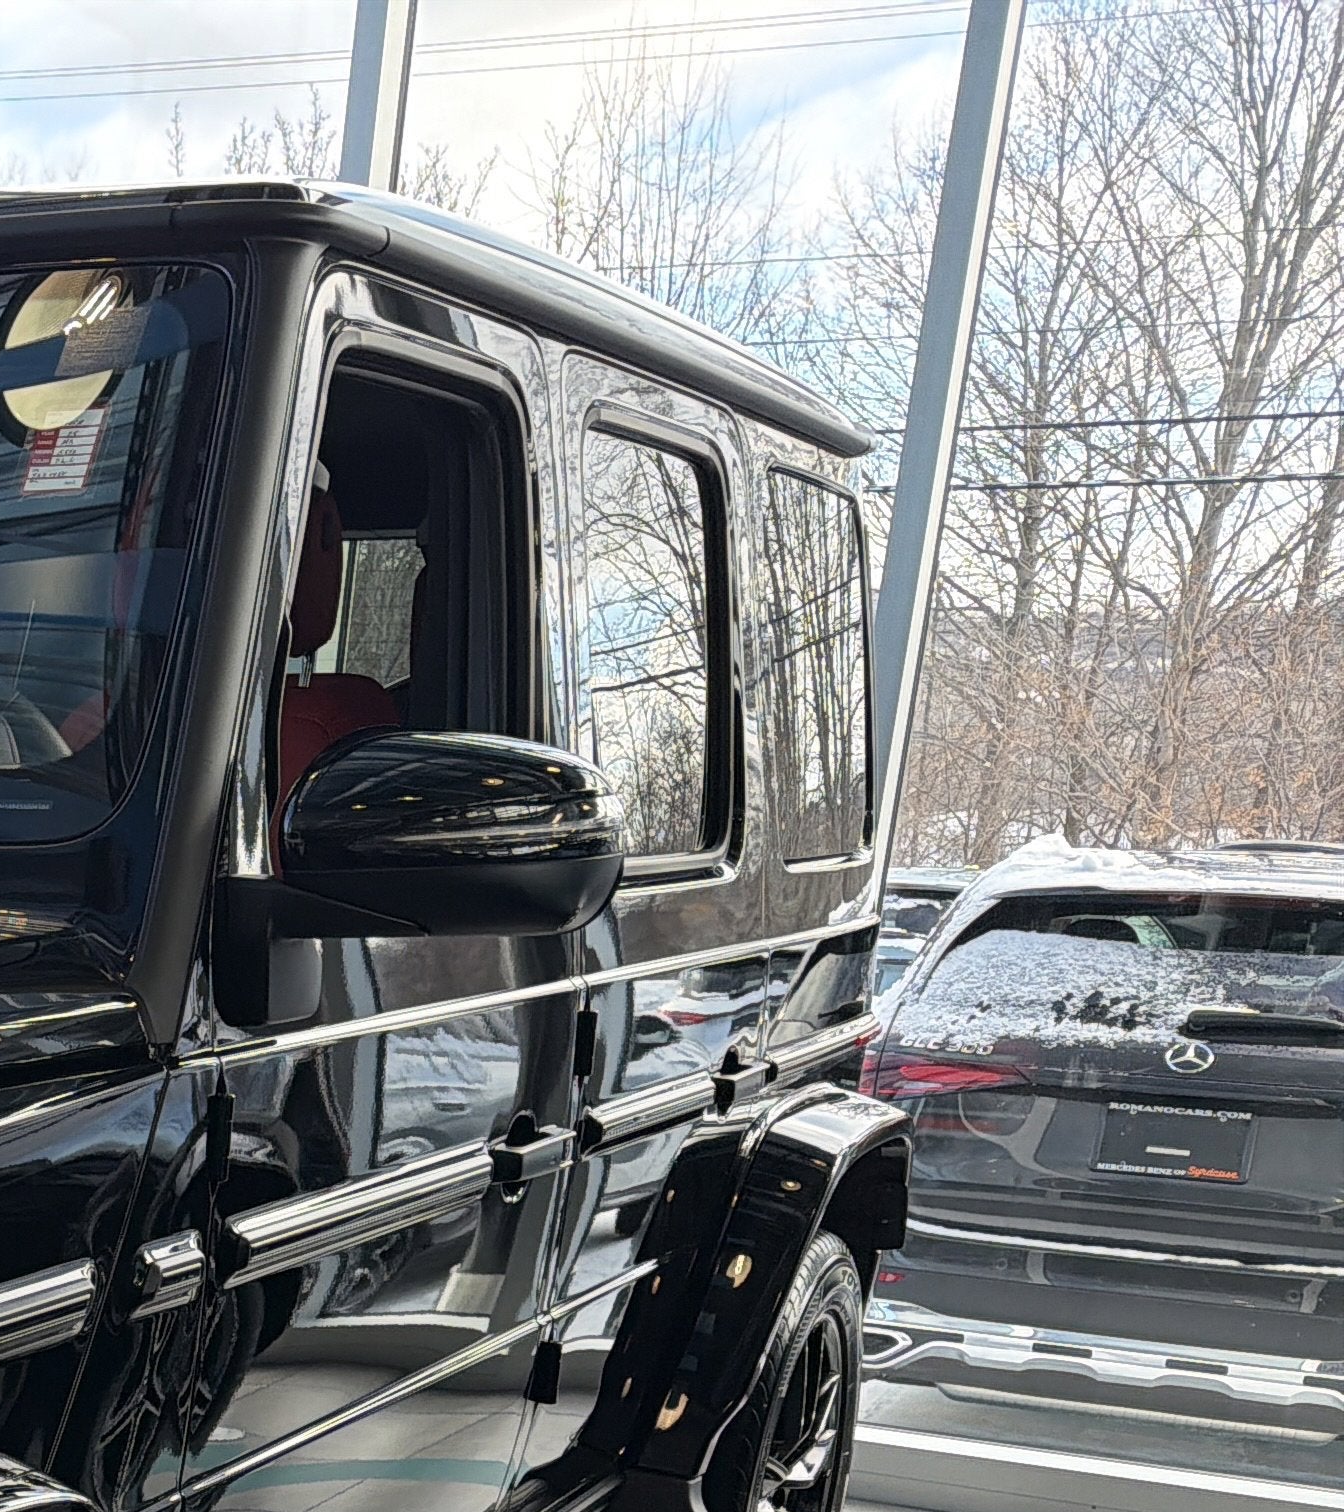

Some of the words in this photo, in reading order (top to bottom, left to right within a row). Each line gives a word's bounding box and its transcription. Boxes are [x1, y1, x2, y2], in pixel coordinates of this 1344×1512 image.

[1109, 1101, 1253, 1120] ROMANOCARS.COM
[1097, 1162, 1146, 1174] MERCEDES
[1147, 1165, 1173, 1176] BENZ
